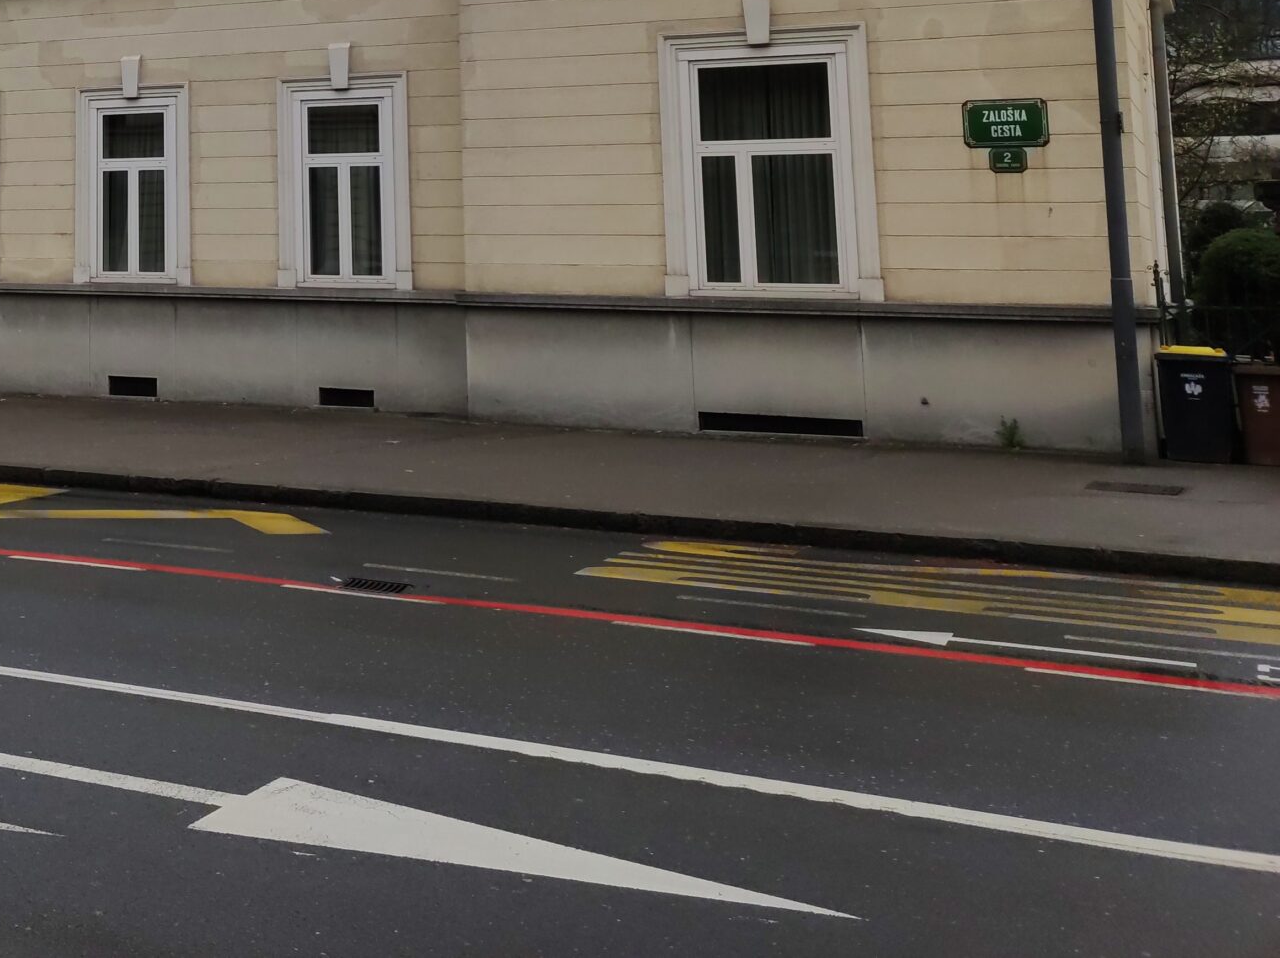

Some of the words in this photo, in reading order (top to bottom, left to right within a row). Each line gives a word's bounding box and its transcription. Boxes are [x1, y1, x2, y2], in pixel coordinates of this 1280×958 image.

[982, 107, 1027, 122] ZALOŠKA
[991, 125, 1022, 137] CESTA
[1003, 152, 1012, 163] 2
